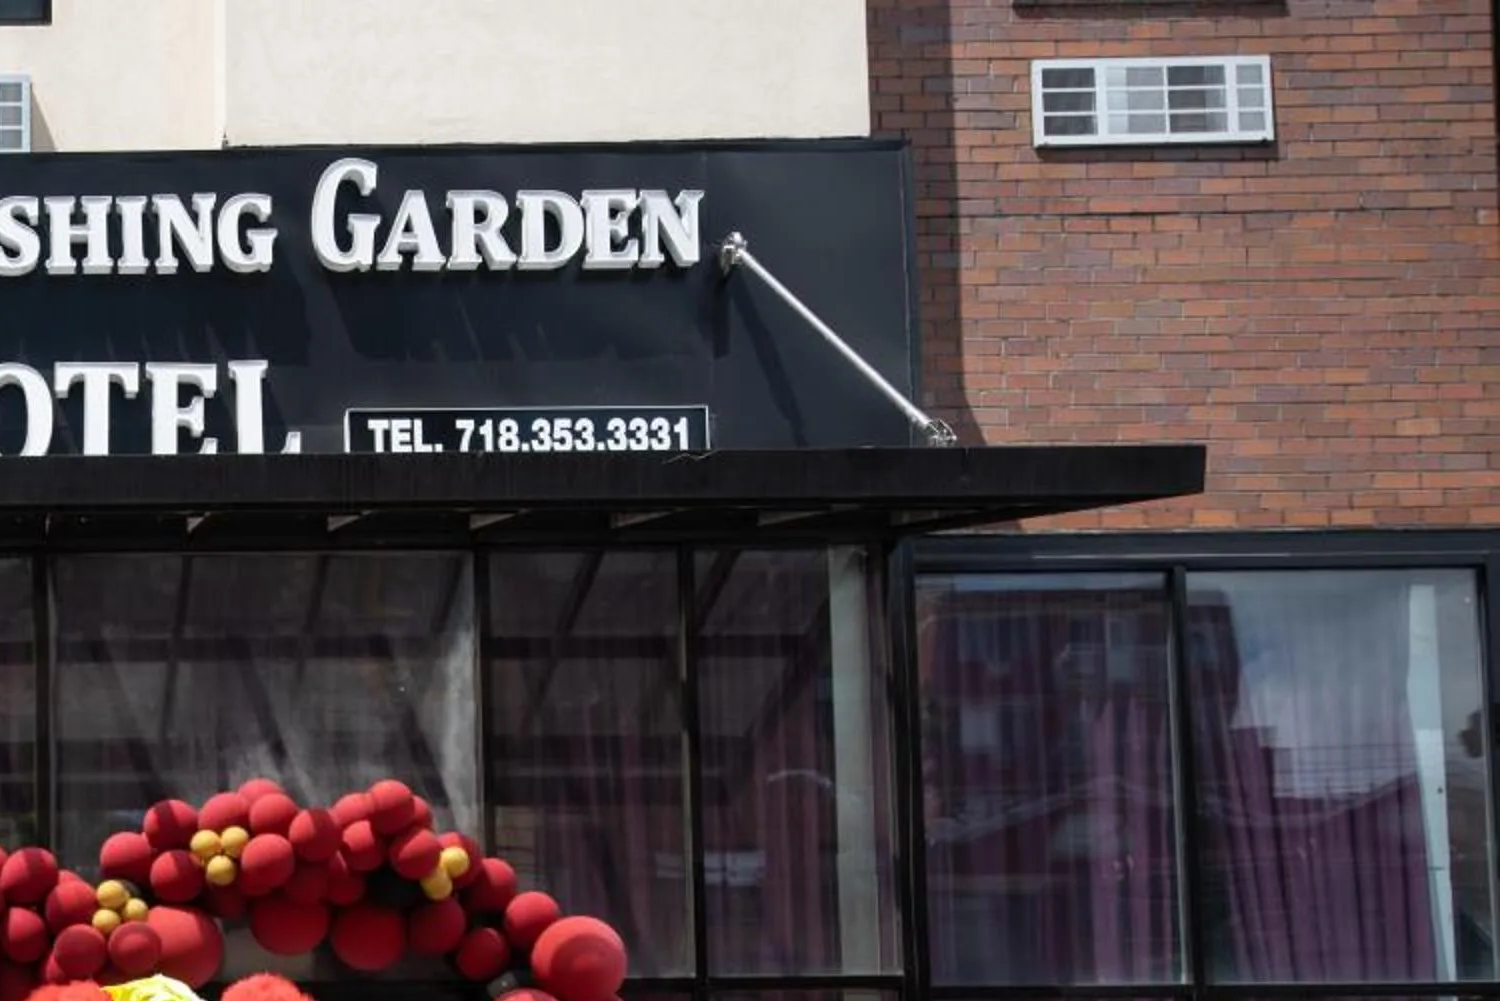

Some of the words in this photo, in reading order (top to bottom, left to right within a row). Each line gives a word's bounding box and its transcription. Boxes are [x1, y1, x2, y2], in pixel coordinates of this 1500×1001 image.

[311, 157, 705, 272] GARDEN
[366, 418, 444, 453] TEL.
[454, 416, 689, 452] 718.353.3331
